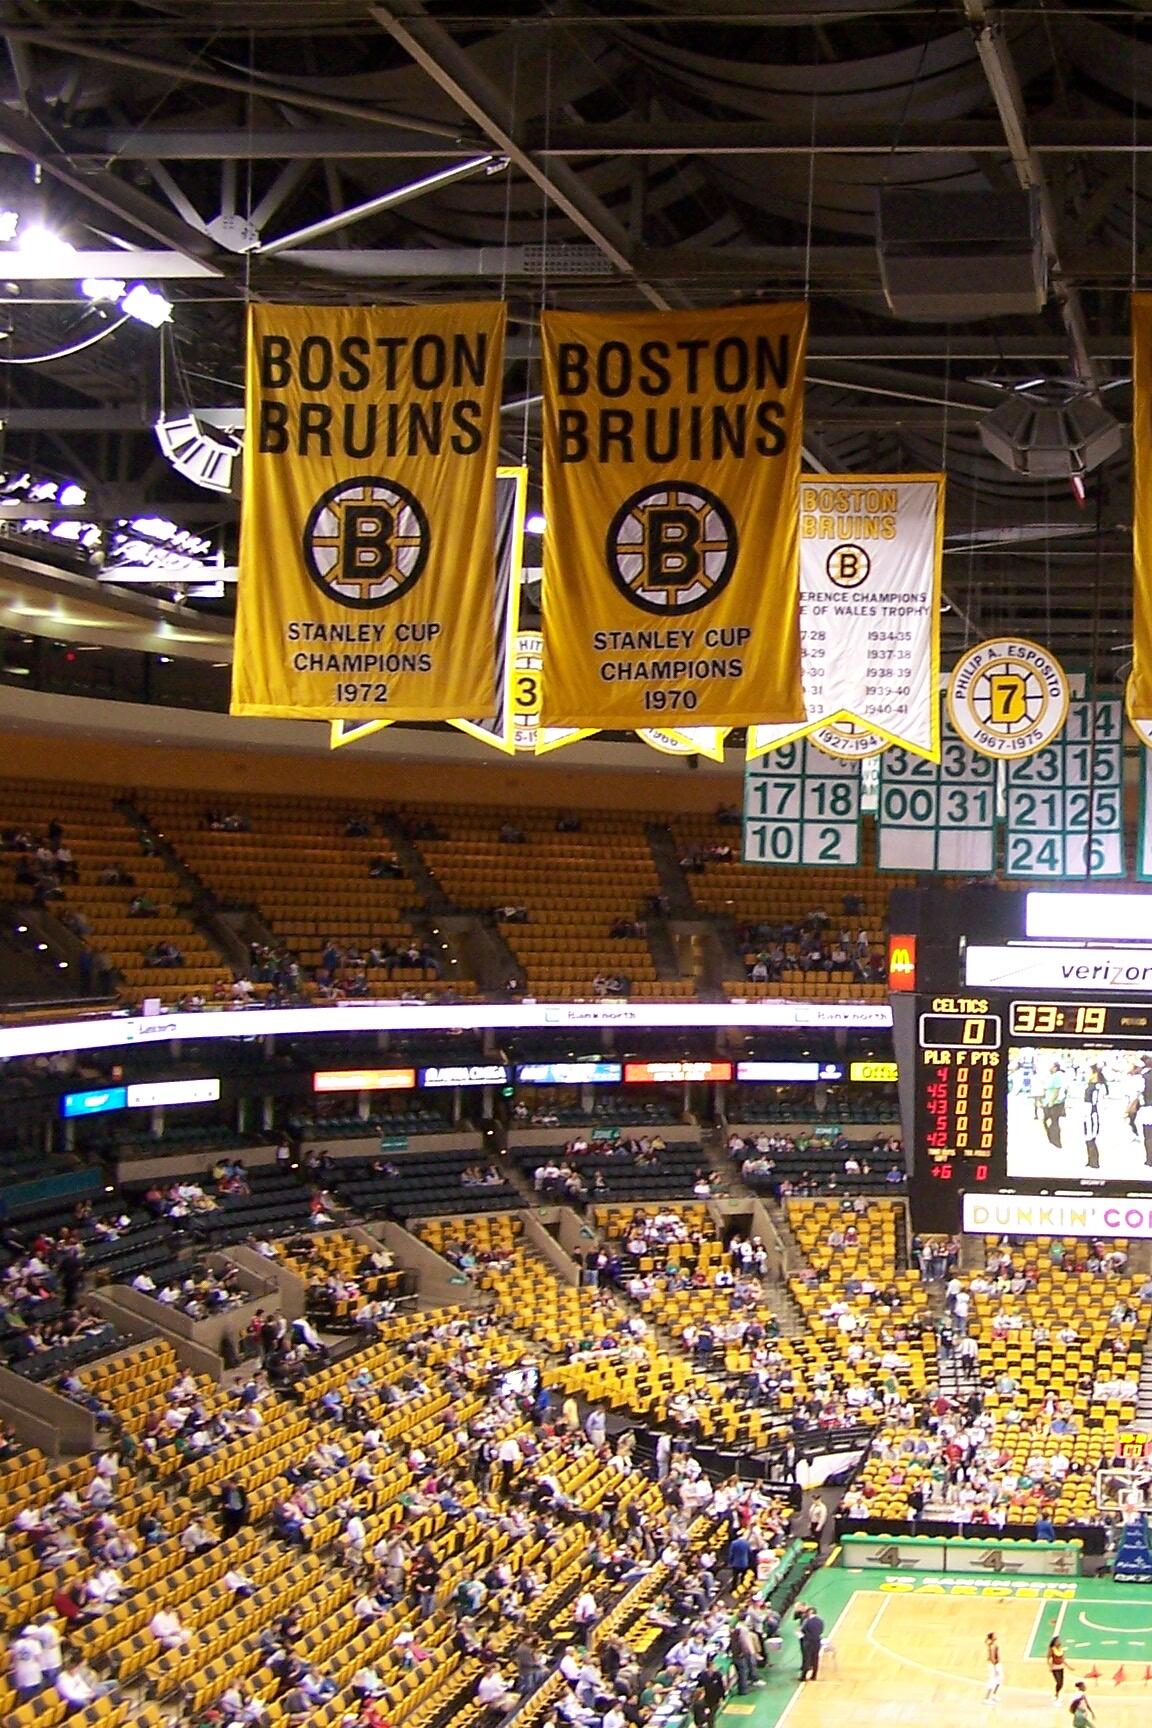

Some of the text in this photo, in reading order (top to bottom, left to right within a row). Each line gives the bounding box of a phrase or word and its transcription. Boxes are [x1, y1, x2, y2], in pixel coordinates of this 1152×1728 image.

[261, 333, 486, 391] BOSTON
[557, 334, 791, 398] BOSTON
[259, 399, 482, 460] BRUINS
[559, 400, 789, 464] BRUINS
[802, 487, 898, 514] BOSTON
[801, 515, 898, 541] BRUINS
[800, 591, 927, 603] ERENCE CHAMPIONS
[812, 605, 829, 616] OF
[834, 605, 877, 617] WALES
[881, 606, 930, 617] TROPHY
[288, 621, 441, 645] STANLEY CUP
[593, 627, 752, 652] STANLEY CUP
[294, 651, 433, 674] CHAMPIONS
[600, 658, 744, 682] CHAMPIONS
[955, 655, 983, 700] PHILIP
[1007, 645, 1061, 699] ESPOSITO
[336, 683, 388, 703] 1972
[515, 677, 538, 706] 3
[643, 690, 698, 711] 1970
[996, 684, 1019, 715] 7
[1072, 704, 1115, 737] 14
[818, 729, 884, 751] 1927-194
[973, 728, 1044, 751] 1967-1975
[944, 744, 992, 777] 35
[1011, 751, 1060, 781] 23
[1072, 748, 1115, 781] 15
[753, 781, 797, 815] 17
[811, 782, 853, 816] 18
[884, 788, 934, 822] 00
[947, 790, 987, 823] 31
[1014, 793, 1056, 827] 21
[1069, 793, 1117, 827] 25
[752, 825, 793, 859] 10
[818, 827, 842, 860] 2
[1011, 838, 1059, 871] 24
[1082, 838, 1106, 872] 6
[932, 998, 989, 1014] CELTICS
[1014, 1005, 1107, 1034] 33:19
[962, 1018, 986, 1044] 0
[924, 1050, 1000, 1066] PLR F PTS
[937, 1068, 994, 1083] 4 0 0
[926, 1084, 994, 1099] 45 0 0
[926, 1100, 993, 1115] 43 0 0
[936, 1116, 993, 1132] 5 0 0
[926, 1132, 993, 1148] 42 0 0
[976, 1165, 988, 1180] 0
[973, 1205, 1096, 1226] DUNKIN'
